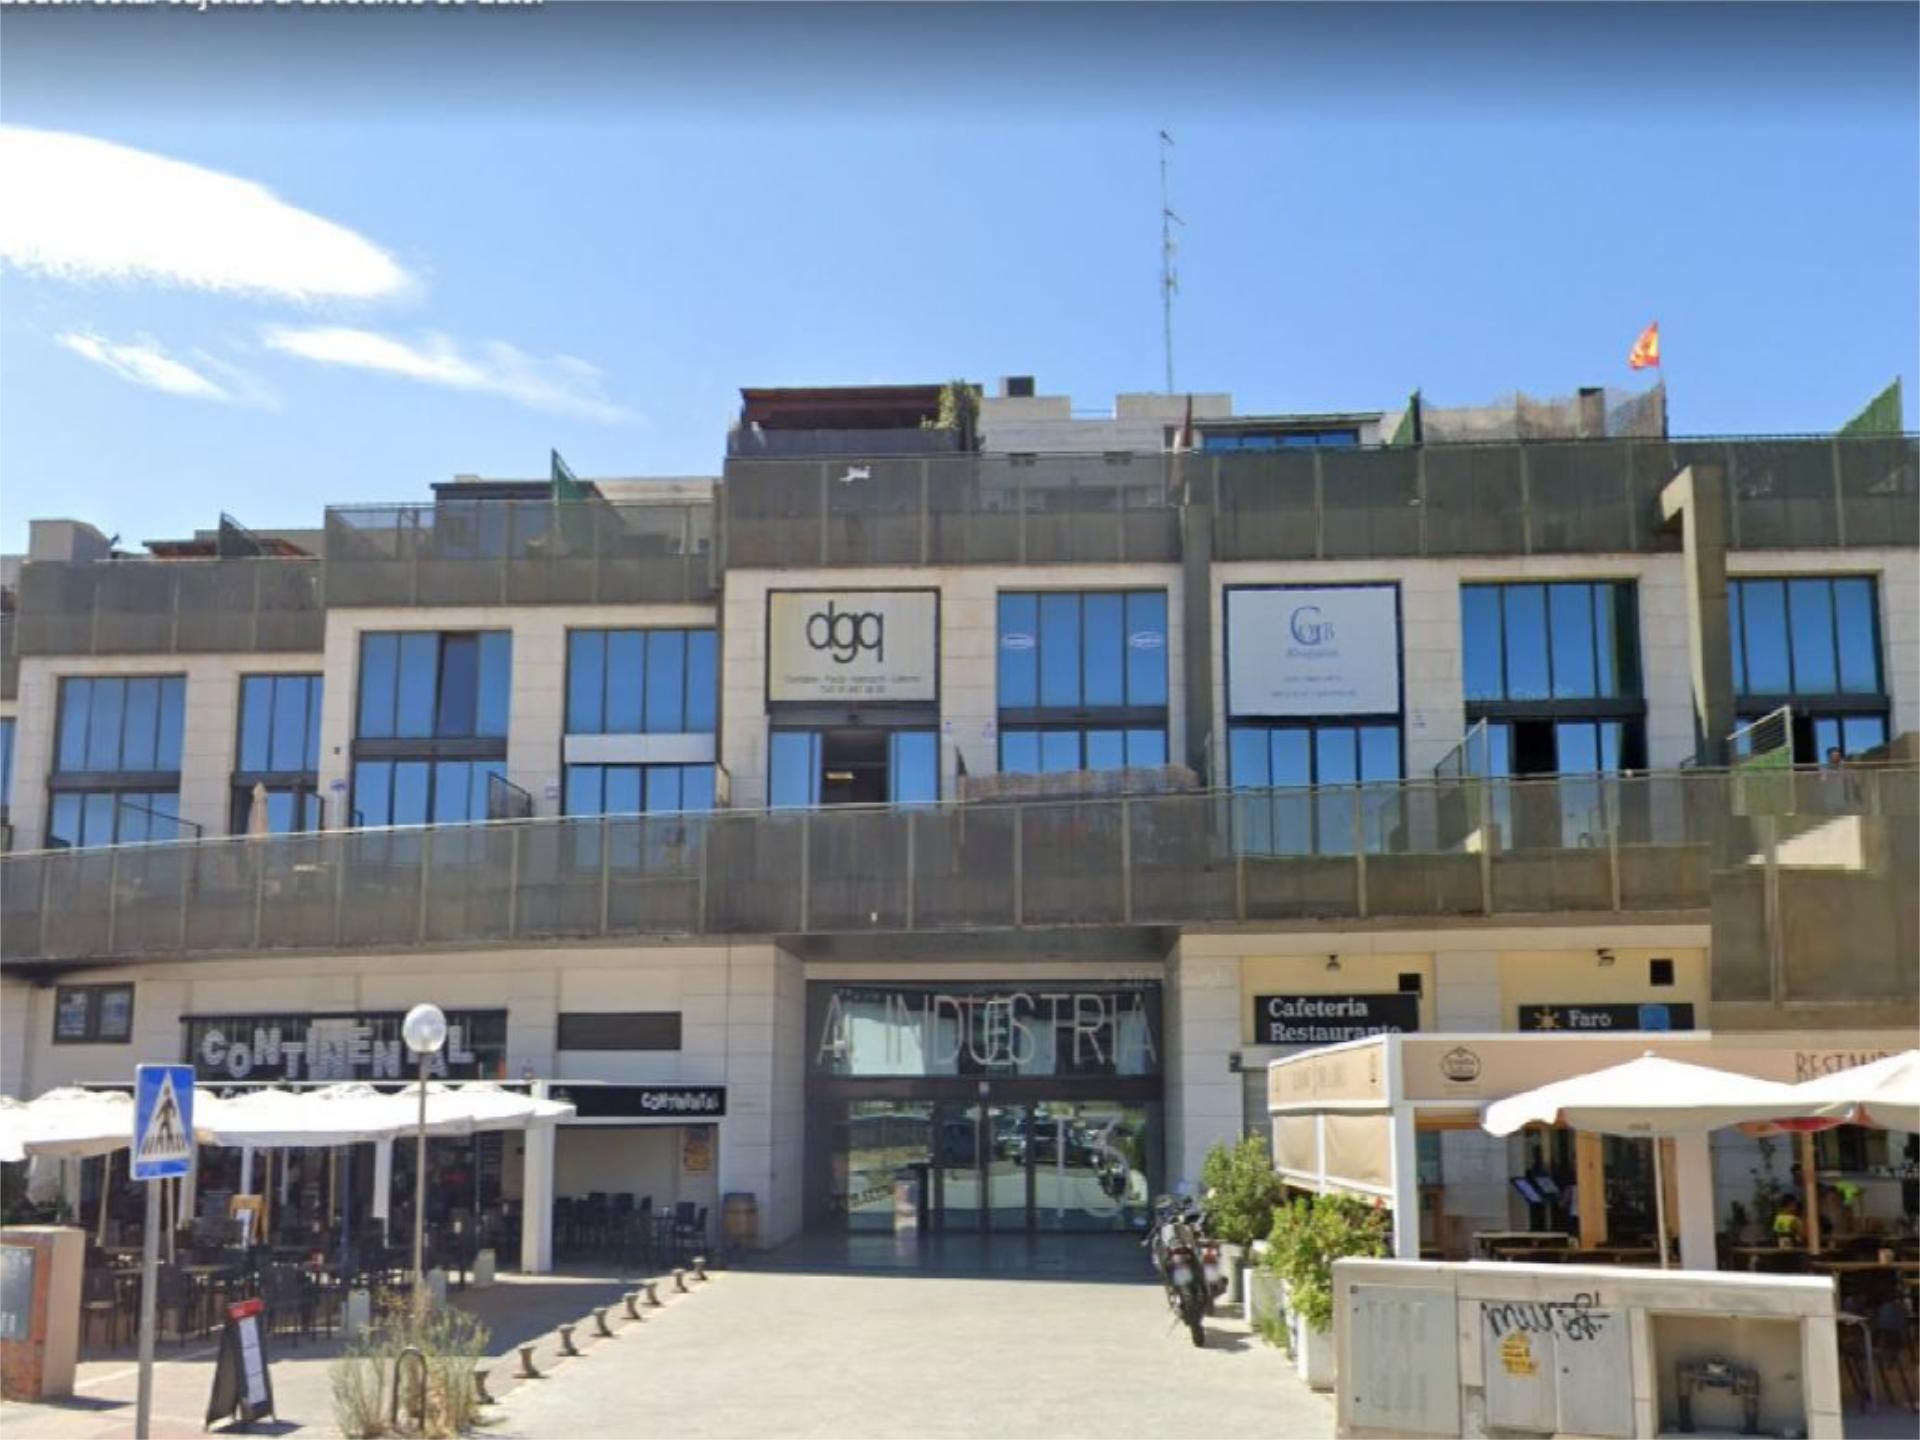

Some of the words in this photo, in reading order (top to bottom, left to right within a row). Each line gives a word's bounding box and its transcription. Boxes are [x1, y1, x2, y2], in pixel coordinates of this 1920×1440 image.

[807, 600, 884, 663] dgq
[885, 992, 1157, 1066] INDUSTRIA
[1269, 998, 1368, 1018] Cafeteria
[1568, 1010, 1612, 1028] Faro
[202, 1025, 475, 1079] CONTINENAL
